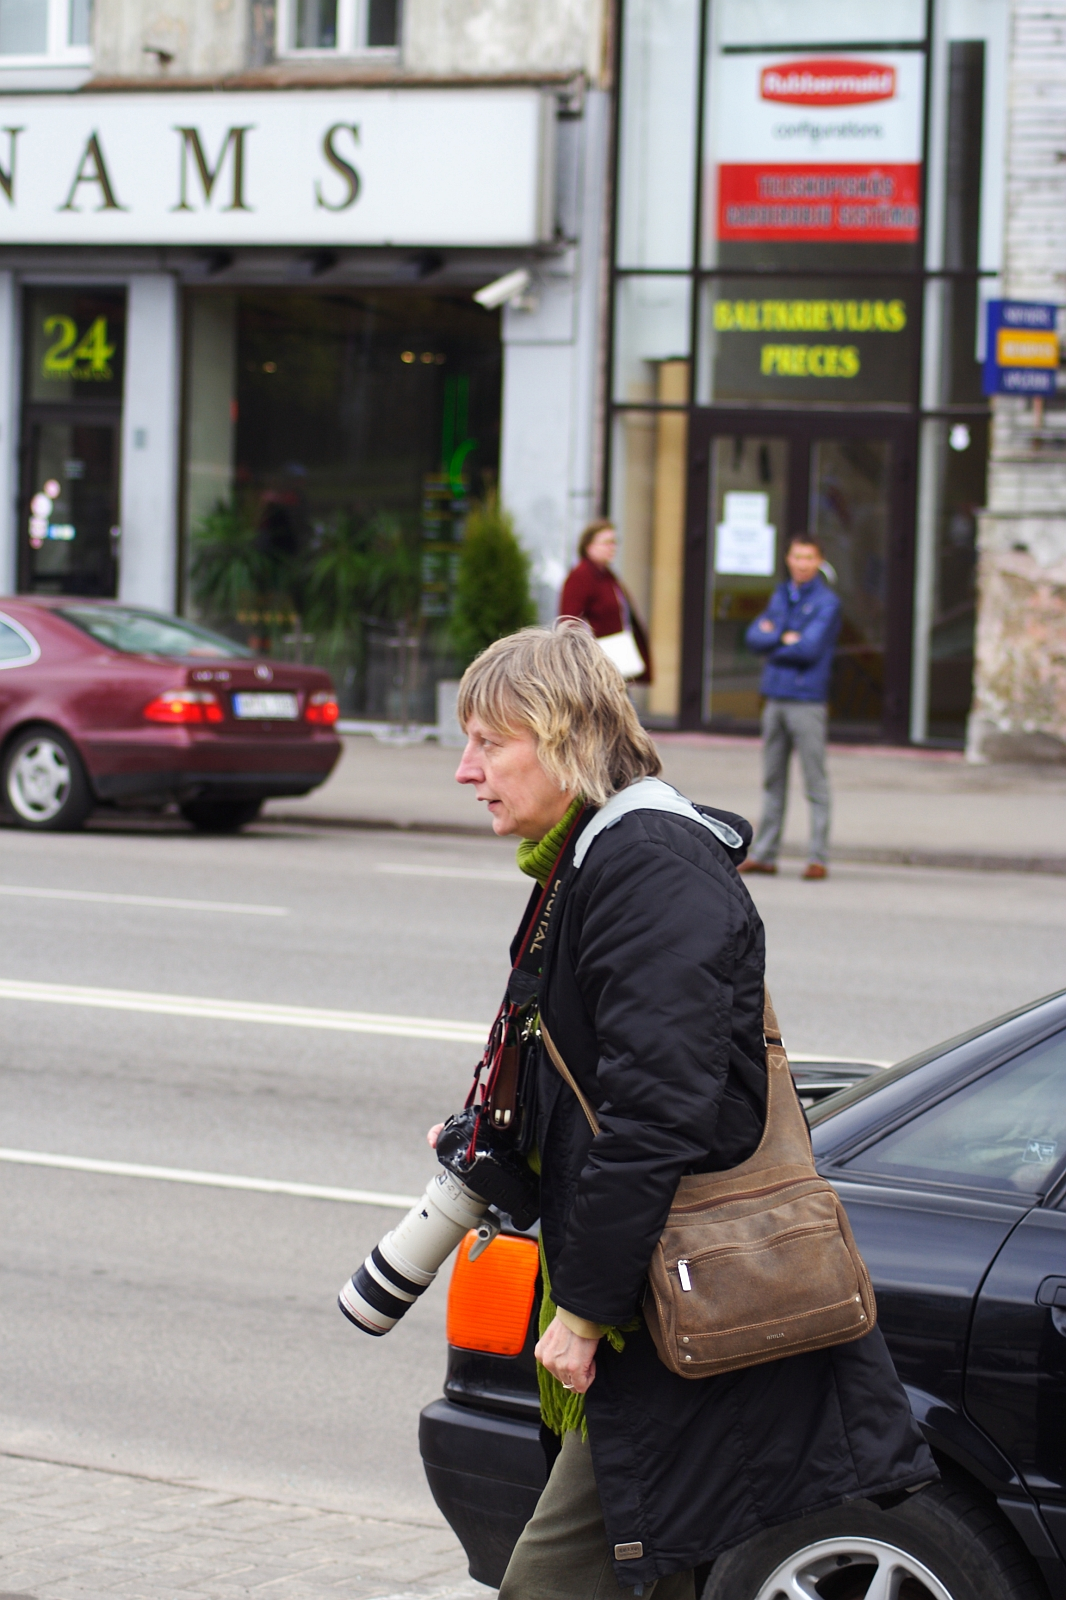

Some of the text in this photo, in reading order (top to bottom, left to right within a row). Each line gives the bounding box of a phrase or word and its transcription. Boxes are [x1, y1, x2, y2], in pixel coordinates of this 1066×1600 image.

[764, 71, 892, 95] Rubbermaid
[43, 314, 115, 369] 24
[760, 344, 860, 378] PRECES
